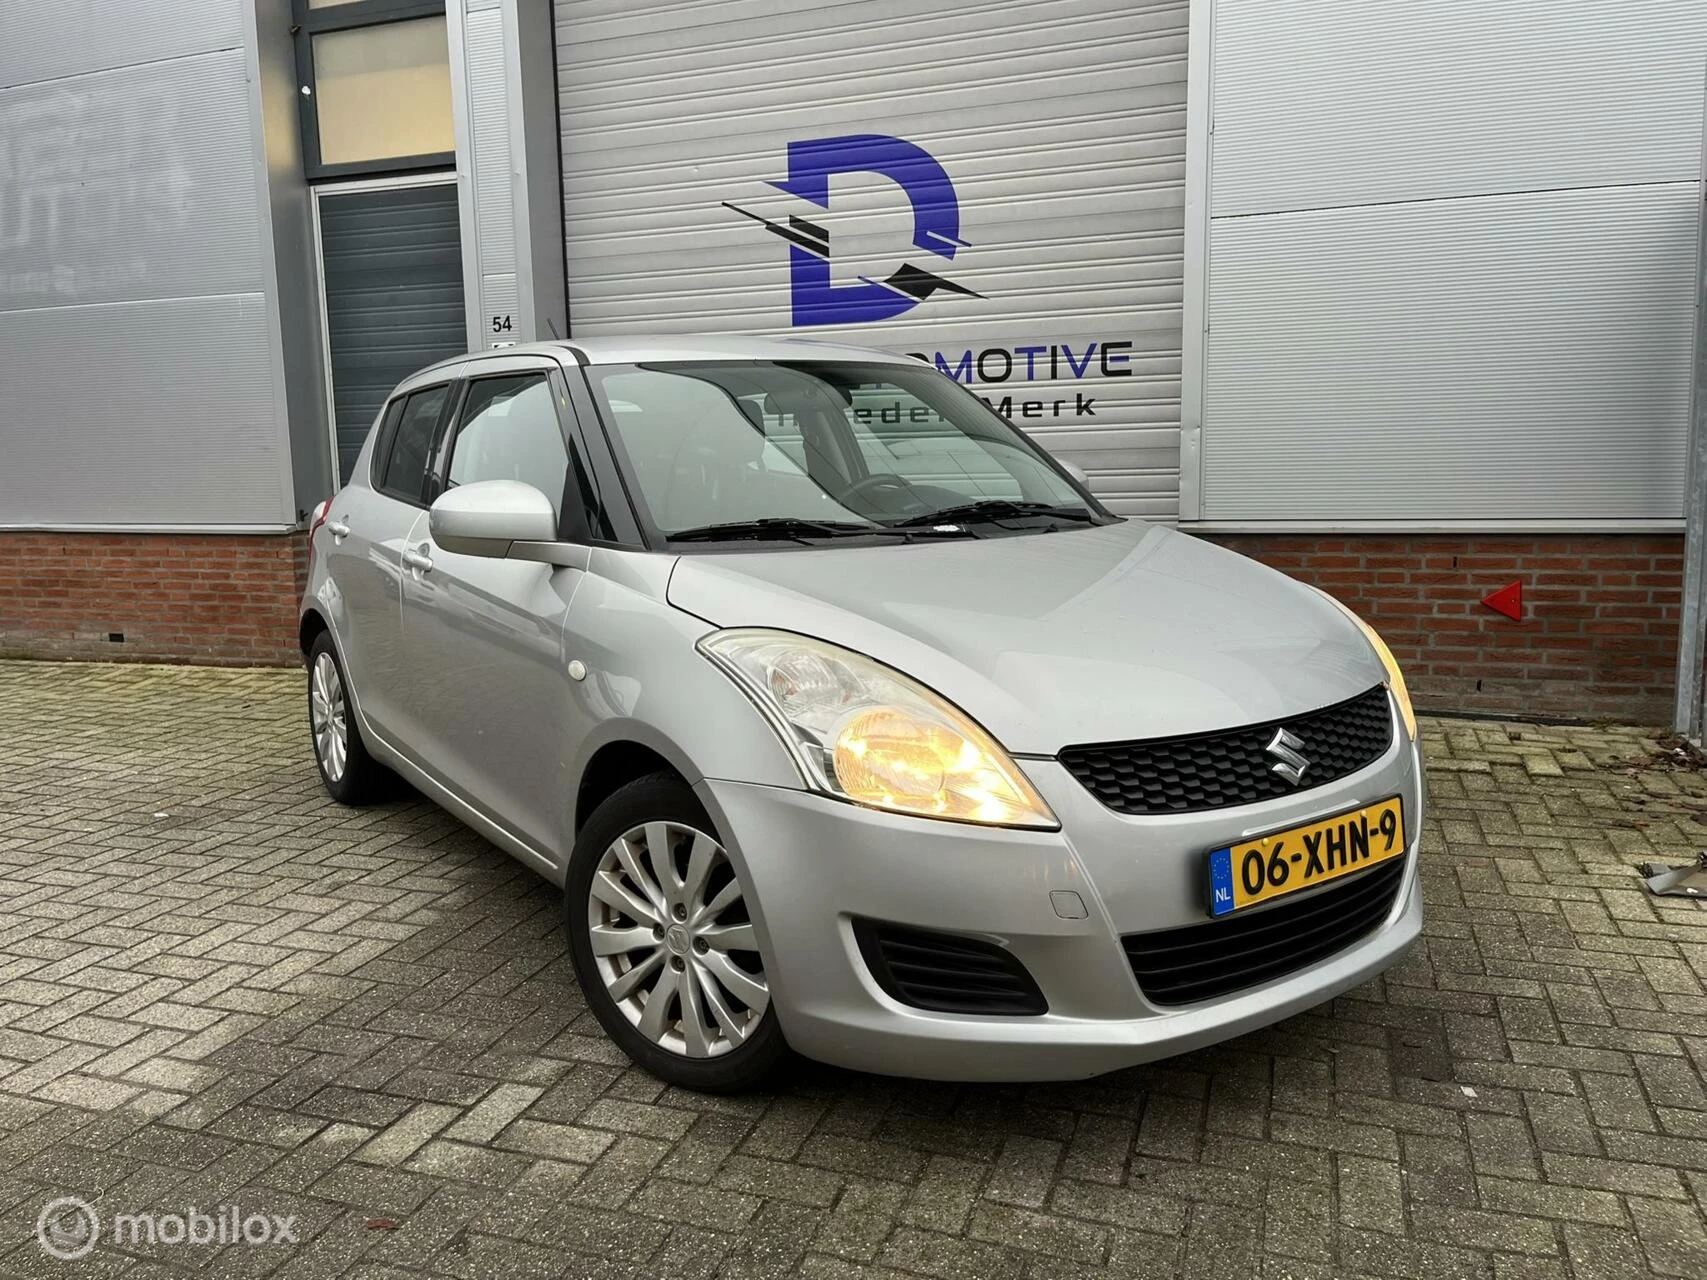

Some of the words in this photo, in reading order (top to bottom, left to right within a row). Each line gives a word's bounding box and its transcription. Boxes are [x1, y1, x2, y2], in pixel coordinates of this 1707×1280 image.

[492, 315, 513, 333] 54
[905, 341, 1133, 385] MOTIVE
[1241, 808, 1398, 896] 06-XHN-9
[1215, 886, 1232, 904] NL
